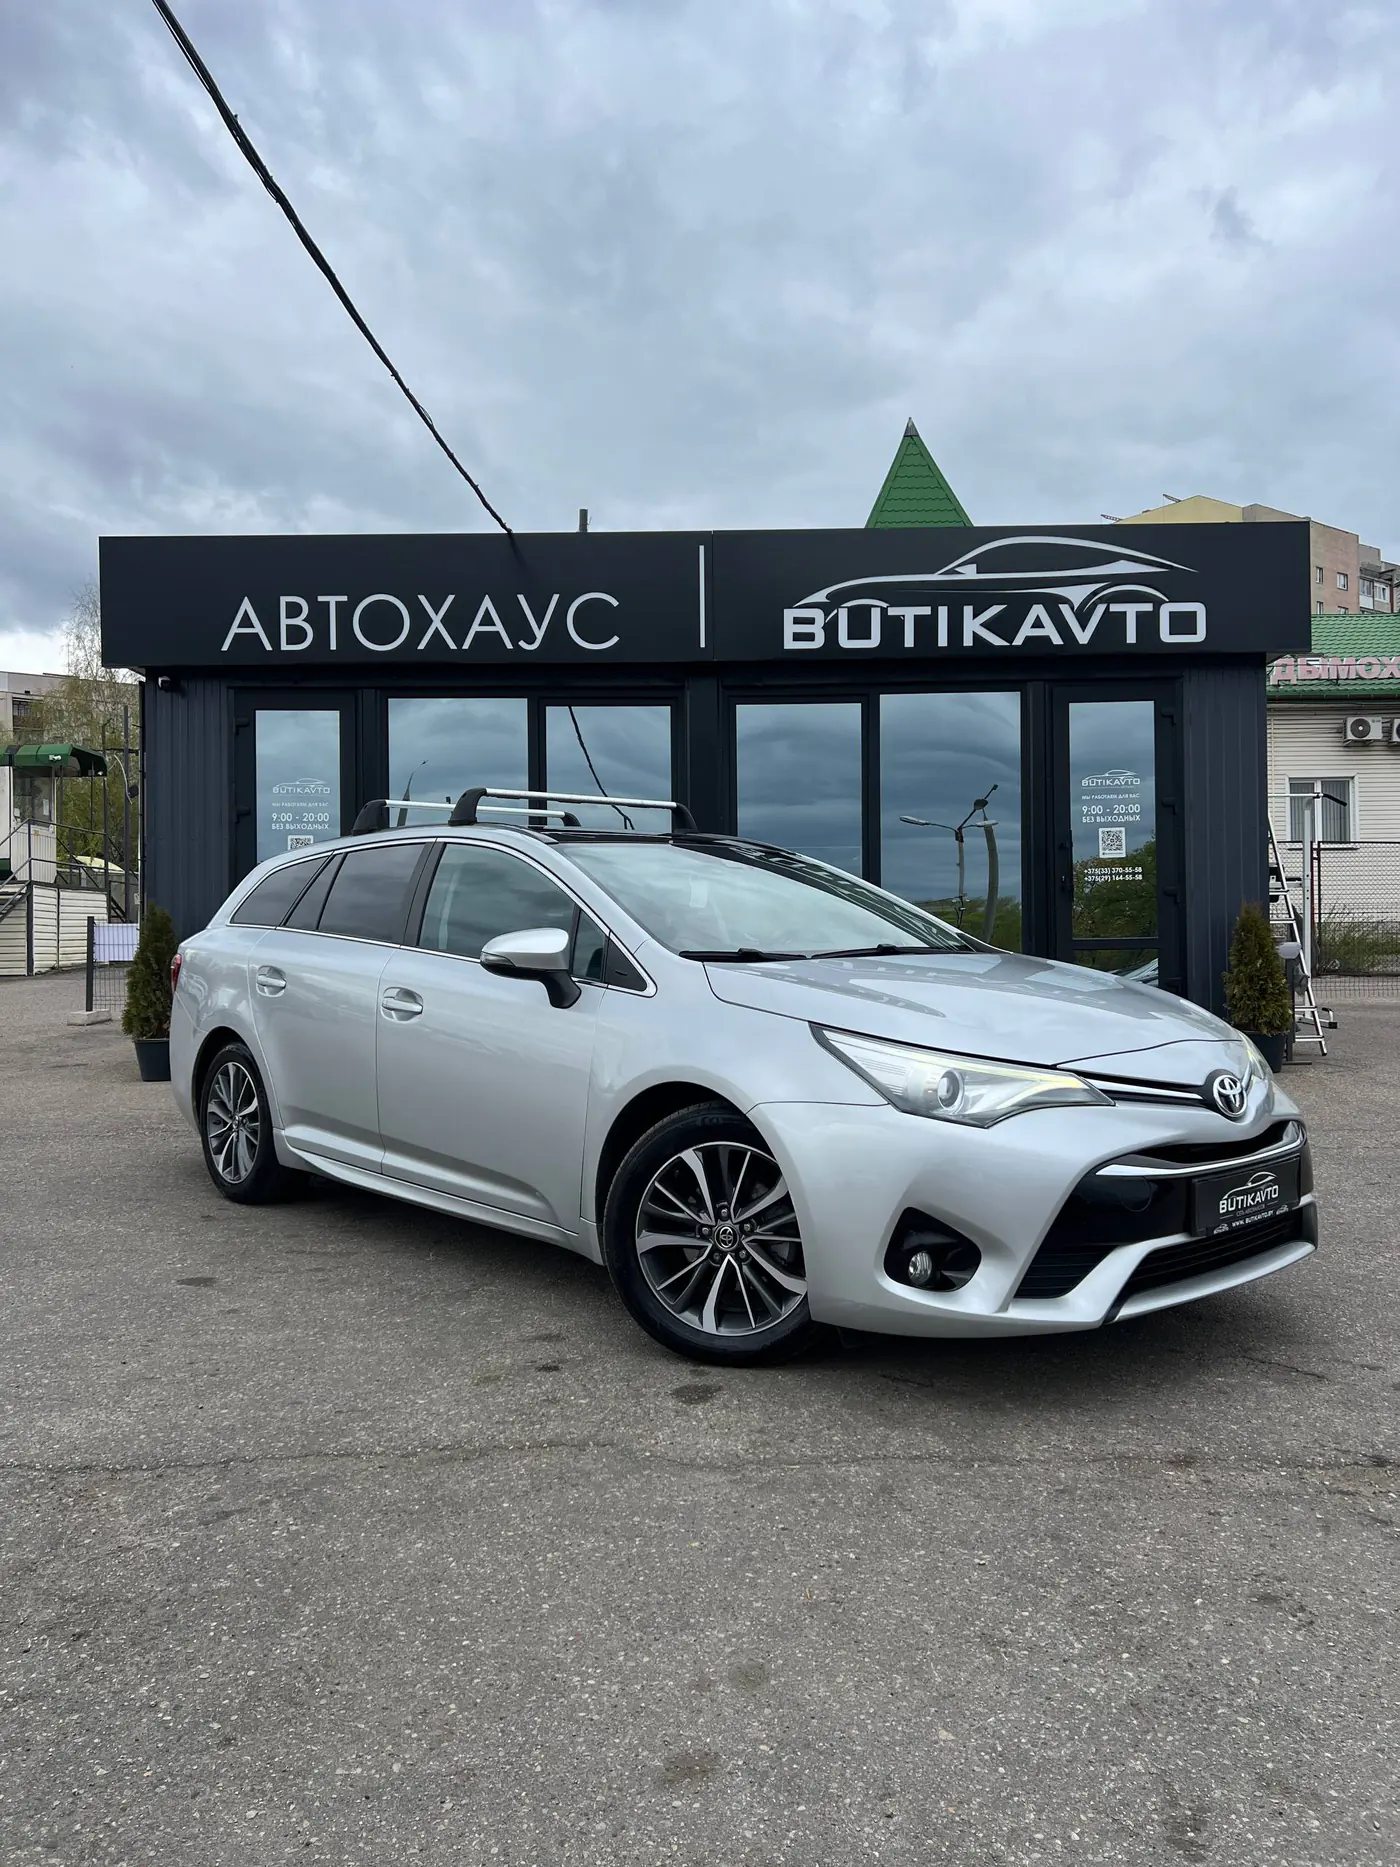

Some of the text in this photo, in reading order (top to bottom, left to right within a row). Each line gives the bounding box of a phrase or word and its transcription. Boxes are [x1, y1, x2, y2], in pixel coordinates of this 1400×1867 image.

[220, 592, 620, 651] АВТОХАУС
[783, 601, 1207, 650] BUTIKAVTO
[1082, 778, 1140, 786] BUTIKAVTO
[272, 786, 331, 794] BUTIKAVTO
[1082, 805, 1103, 815] 9:00
[1113, 804, 1141, 814] 20:00
[271, 812, 293, 822] 9:00
[302, 812, 330, 822] 20:00
[1219, 1185, 1279, 1214] BUTIKAVTO
